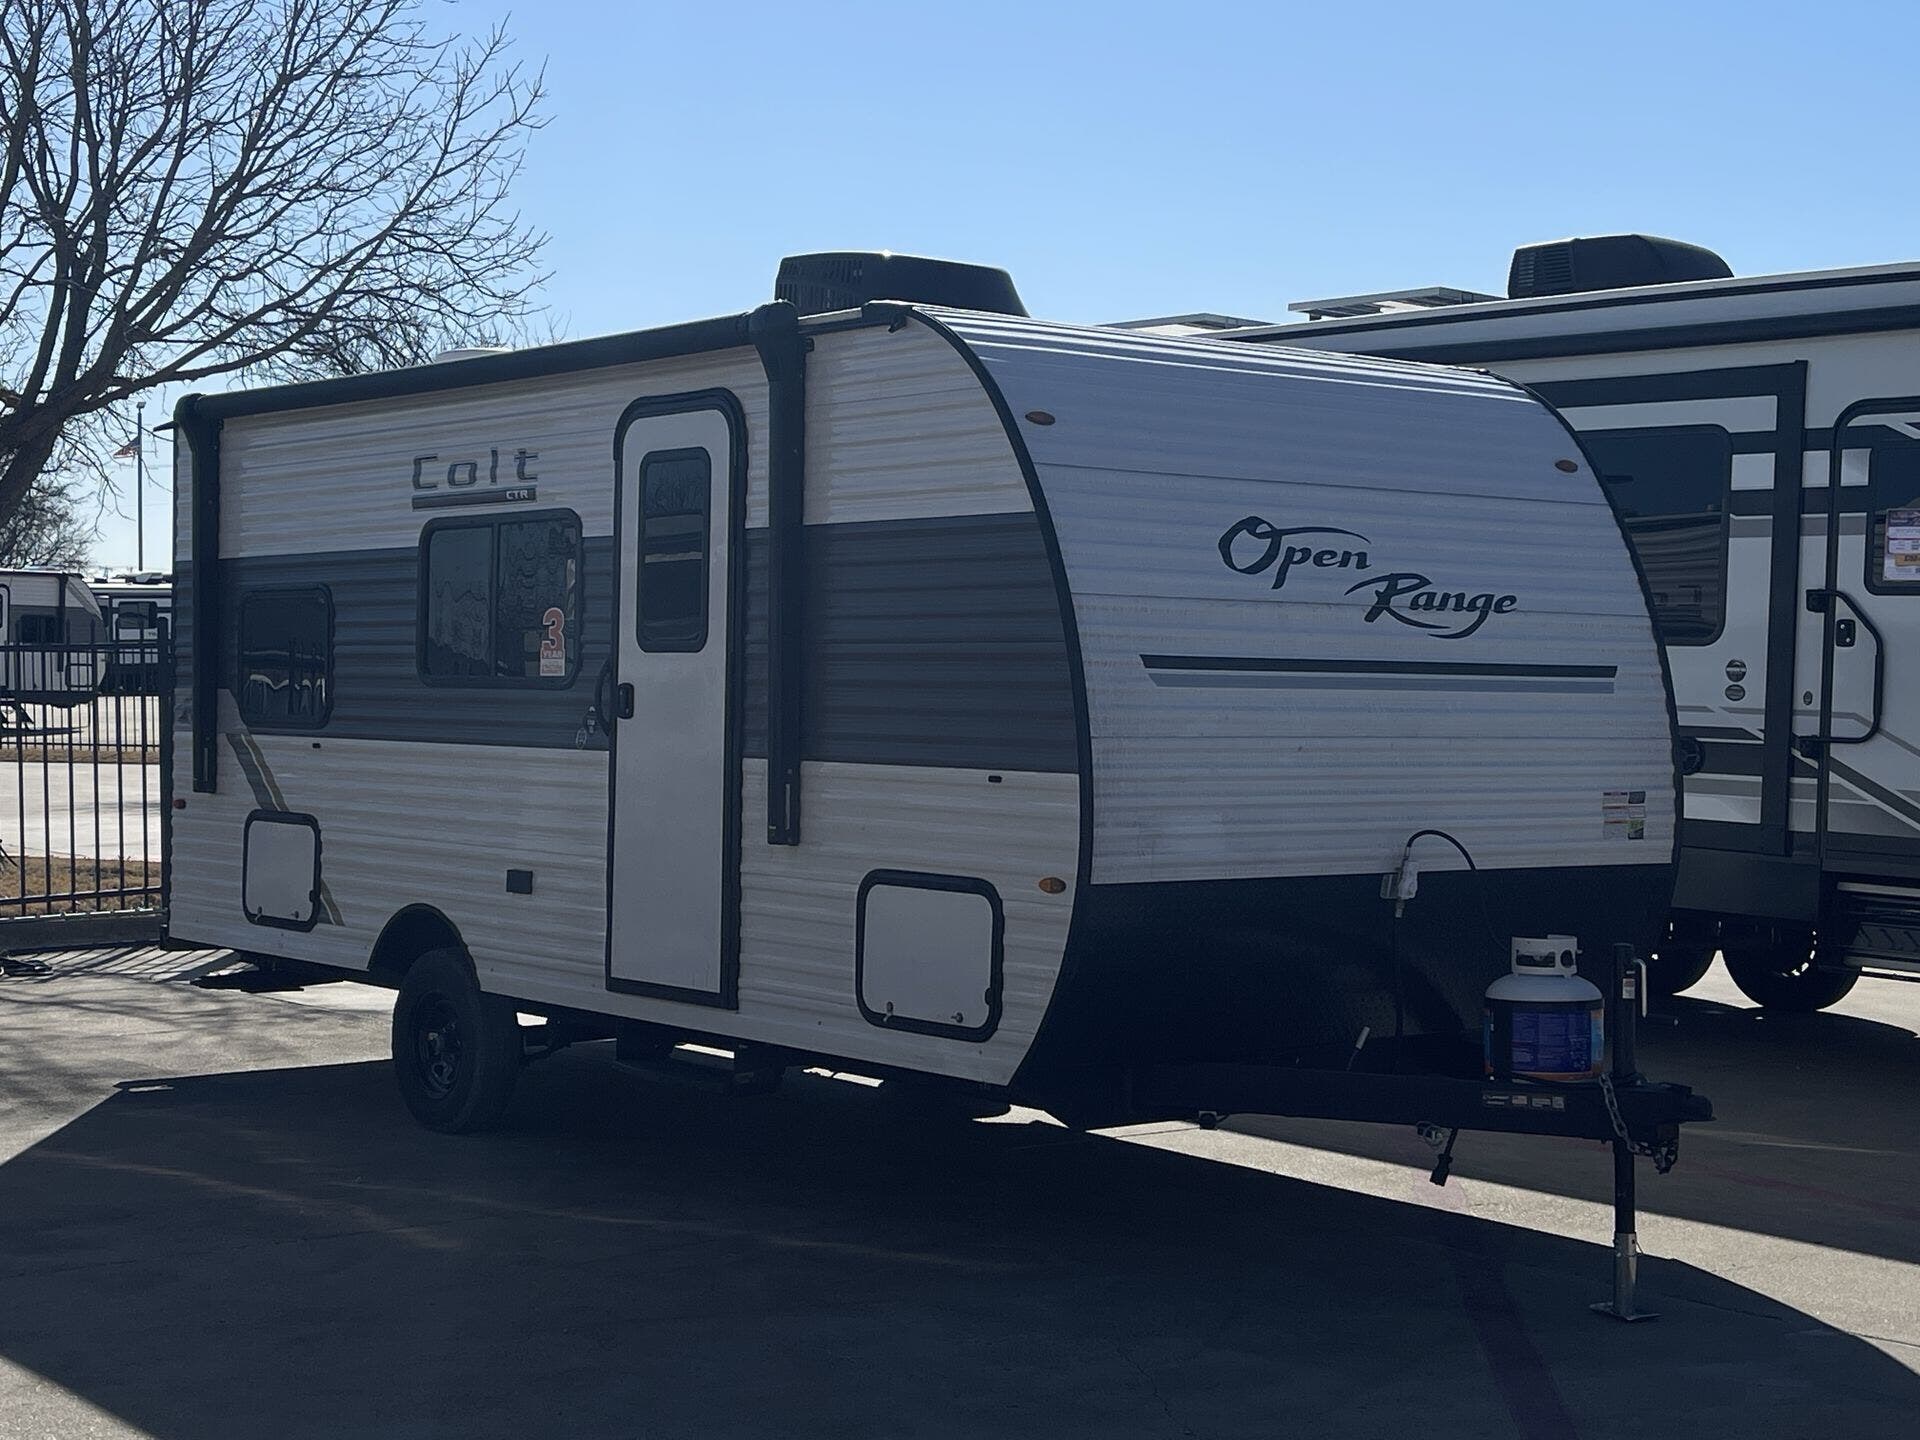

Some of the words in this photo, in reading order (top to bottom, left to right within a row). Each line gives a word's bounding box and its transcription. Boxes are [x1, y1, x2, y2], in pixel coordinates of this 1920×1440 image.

[412, 448, 538, 490] Colt
[506, 489, 529, 500] CTR
[1218, 516, 1371, 590] Open
[1344, 573, 1518, 639] Range
[542, 607, 565, 651] 3
